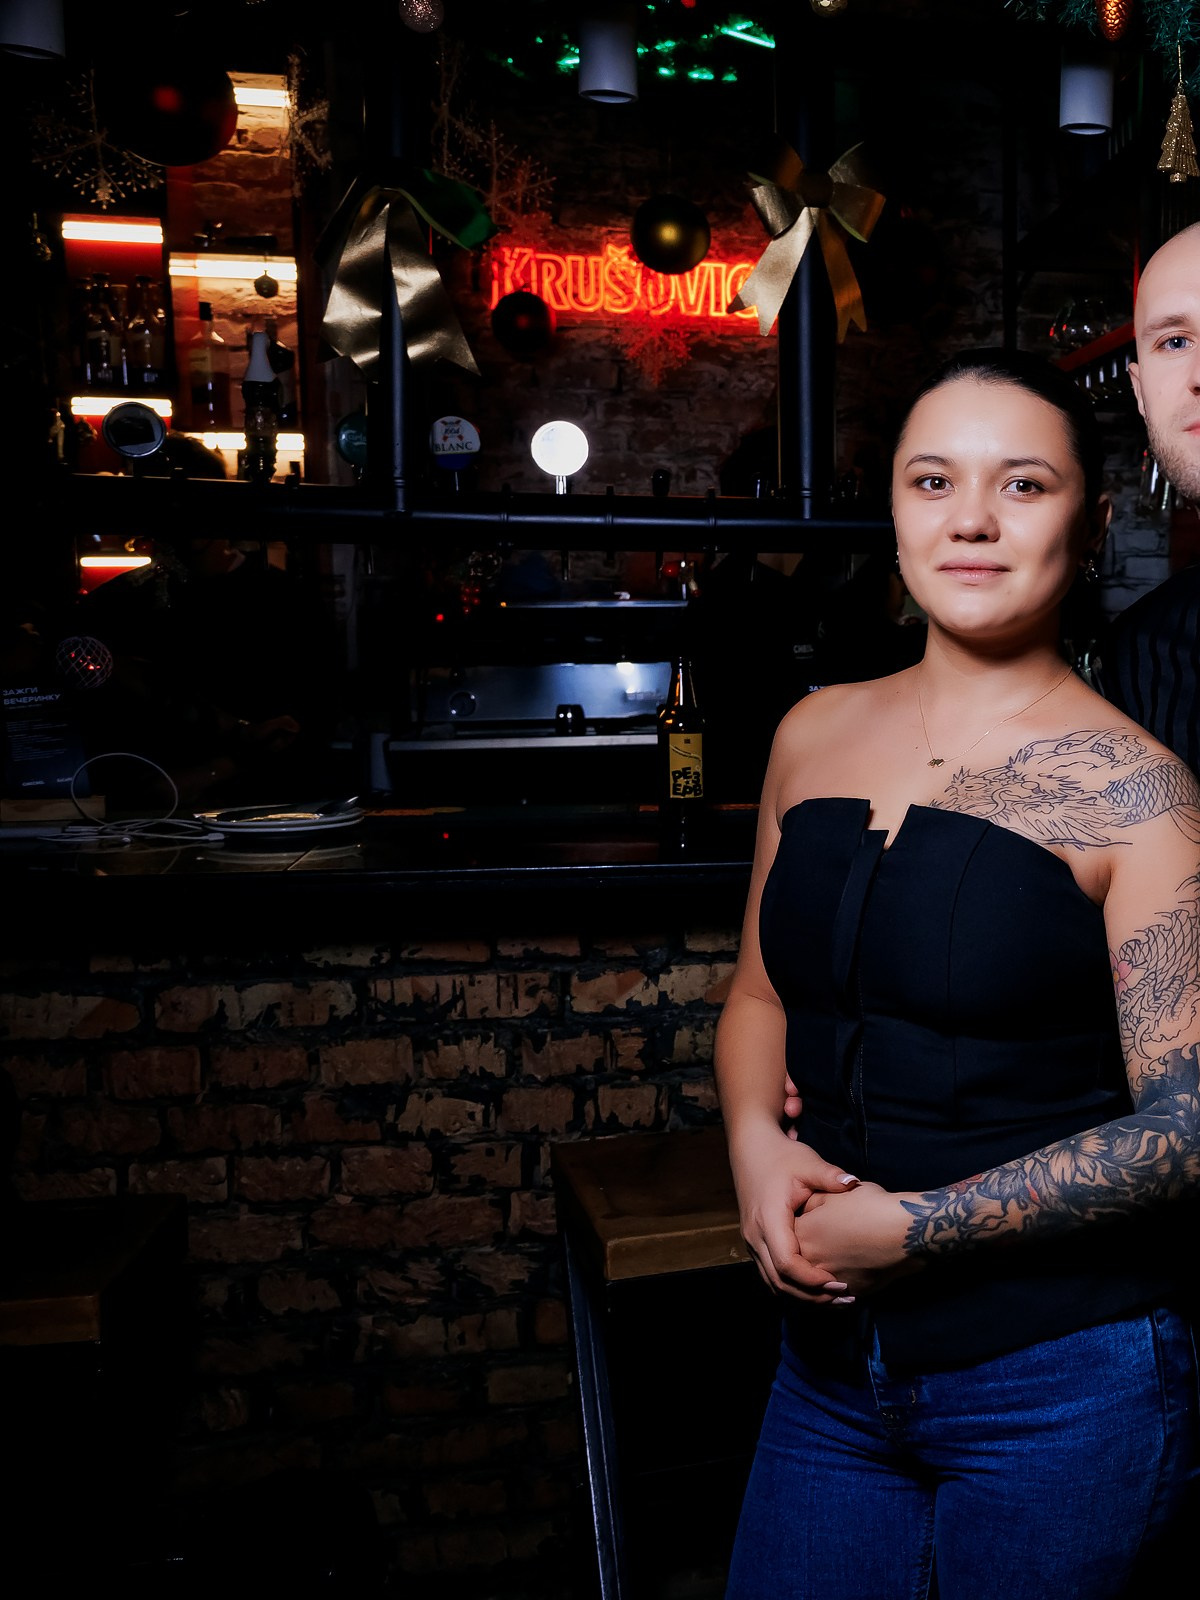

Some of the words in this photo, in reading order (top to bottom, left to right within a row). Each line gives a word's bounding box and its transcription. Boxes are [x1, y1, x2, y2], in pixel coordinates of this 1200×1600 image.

[434, 441, 473, 452] BLANC
[3, 687, 38, 696] ЗАЖГИ
[3, 694, 61, 705] ВЕЧЕРИНКУ
